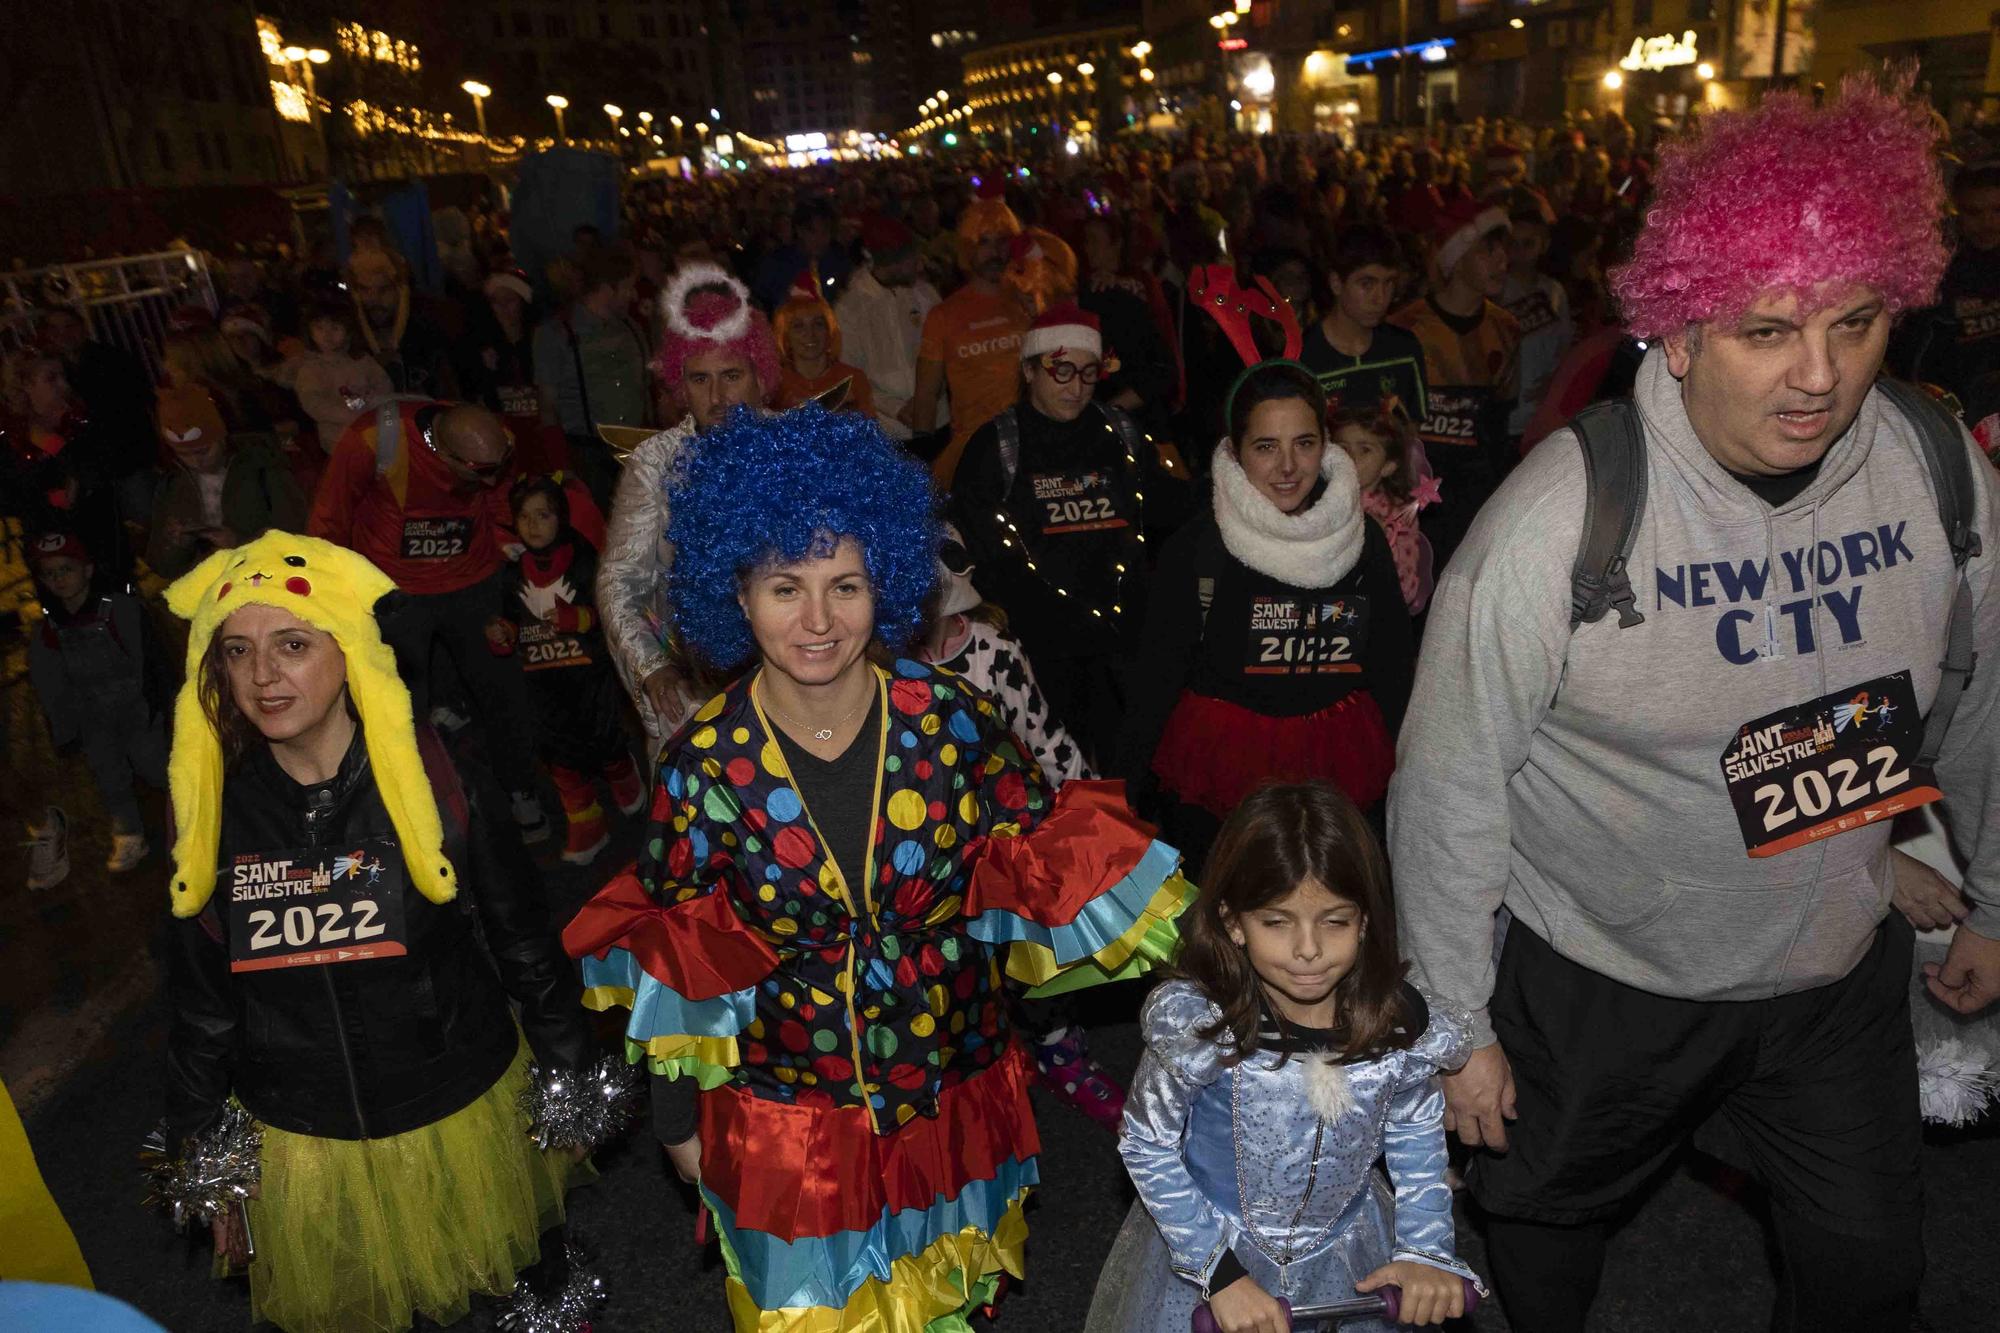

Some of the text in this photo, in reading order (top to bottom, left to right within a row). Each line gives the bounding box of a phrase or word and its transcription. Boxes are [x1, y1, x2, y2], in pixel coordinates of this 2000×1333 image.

[1420, 414, 1475, 437] 2022
[1033, 476, 1063, 491] SANT
[1046, 497, 1116, 524] 2022
[408, 538, 465, 556] 2022
[1656, 520, 1914, 610] NEW YORK
[1252, 603, 1296, 619] SANT
[1716, 586, 1862, 665] CITY
[527, 638, 584, 664] 2022
[1754, 745, 1910, 833] 2022
[233, 854, 261, 864] 2022
[234, 860, 294, 886] SANT
[248, 900, 386, 951] 2022
